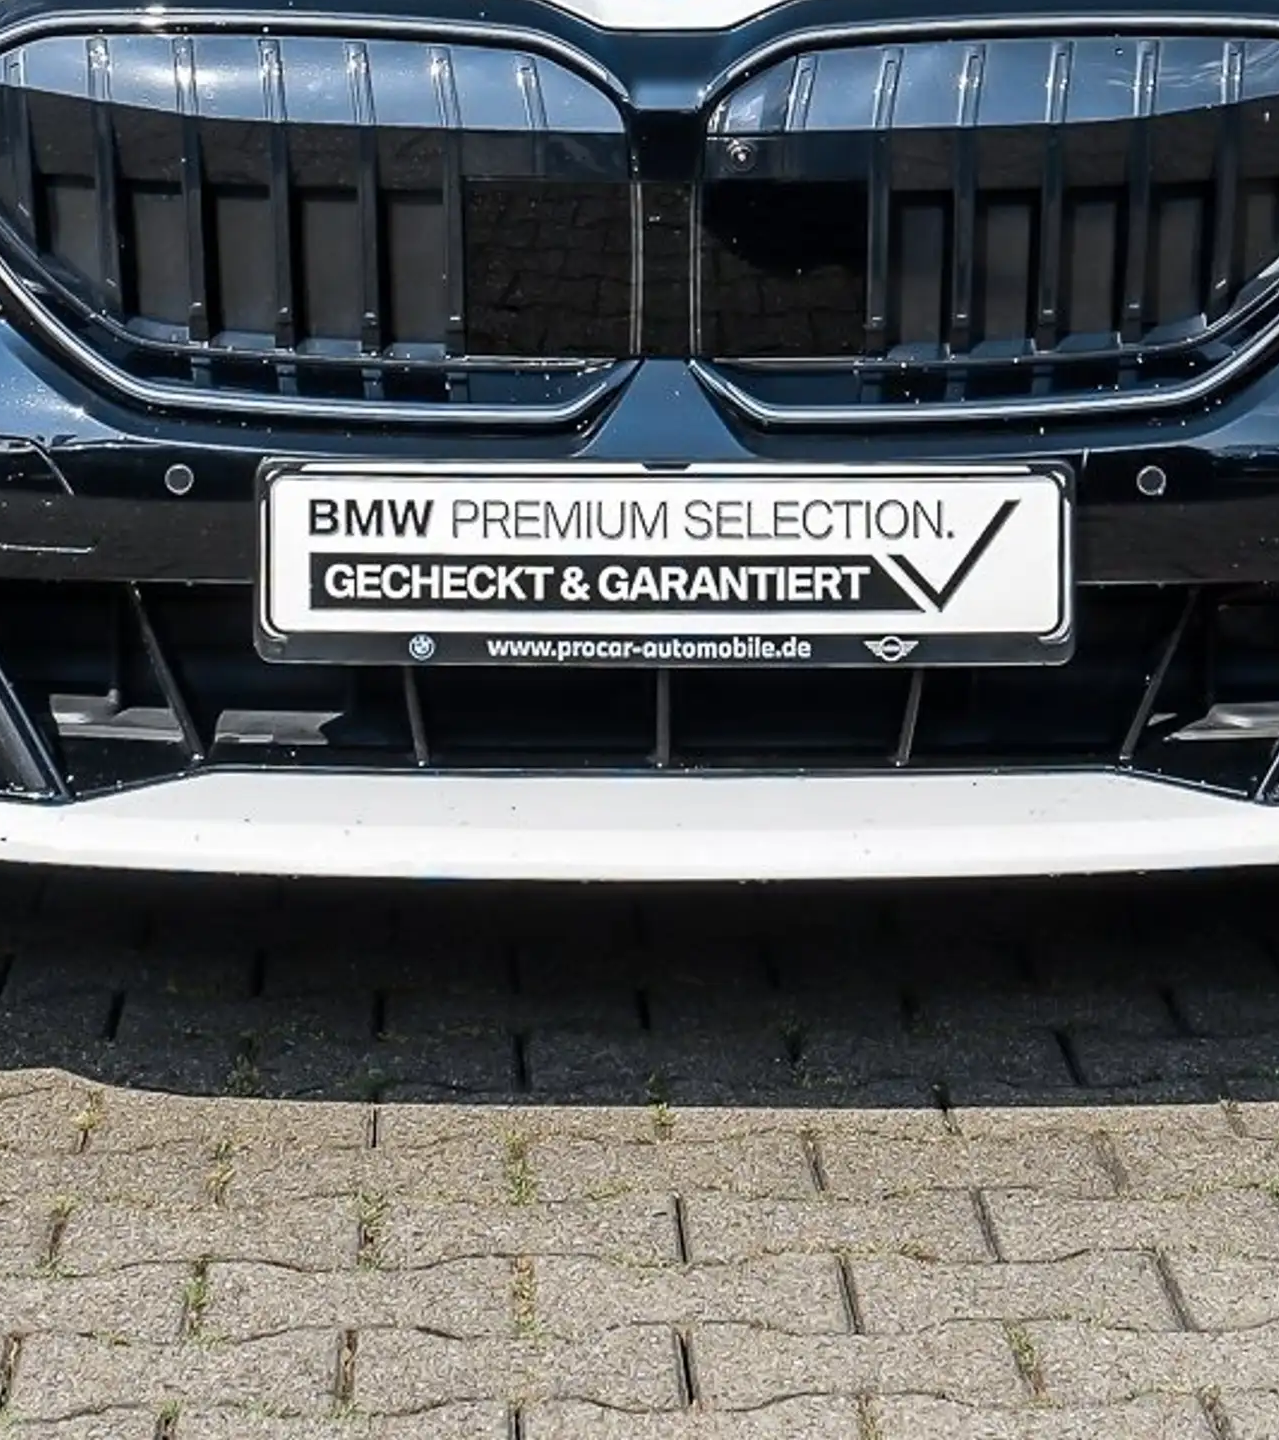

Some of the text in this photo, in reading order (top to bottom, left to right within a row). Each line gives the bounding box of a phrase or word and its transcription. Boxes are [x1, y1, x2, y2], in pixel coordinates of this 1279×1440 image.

[308, 499, 955, 540] BMW PREMIUM SELECTION.
[324, 563, 871, 601] GECHECKT & GARANTIERT
[487, 637, 811, 662] www.procar-automobile.de
